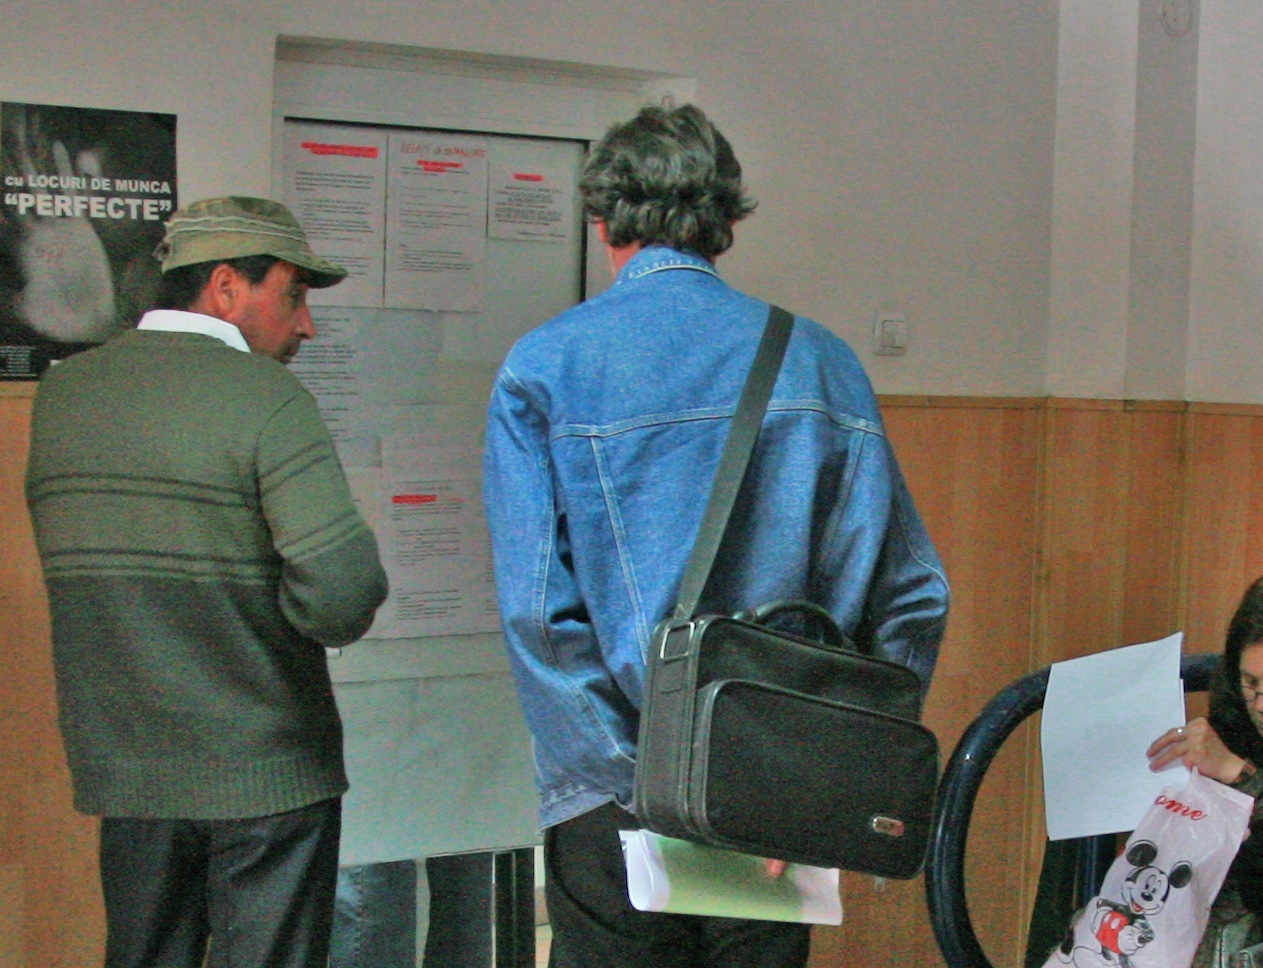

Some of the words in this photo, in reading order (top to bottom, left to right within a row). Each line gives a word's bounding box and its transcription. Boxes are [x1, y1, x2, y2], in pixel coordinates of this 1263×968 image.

[5, 176, 24, 187] cu
[28, 174, 87, 189] LOCURI
[91, 177, 112, 191] DE
[115, 179, 172, 195] MUNCA
